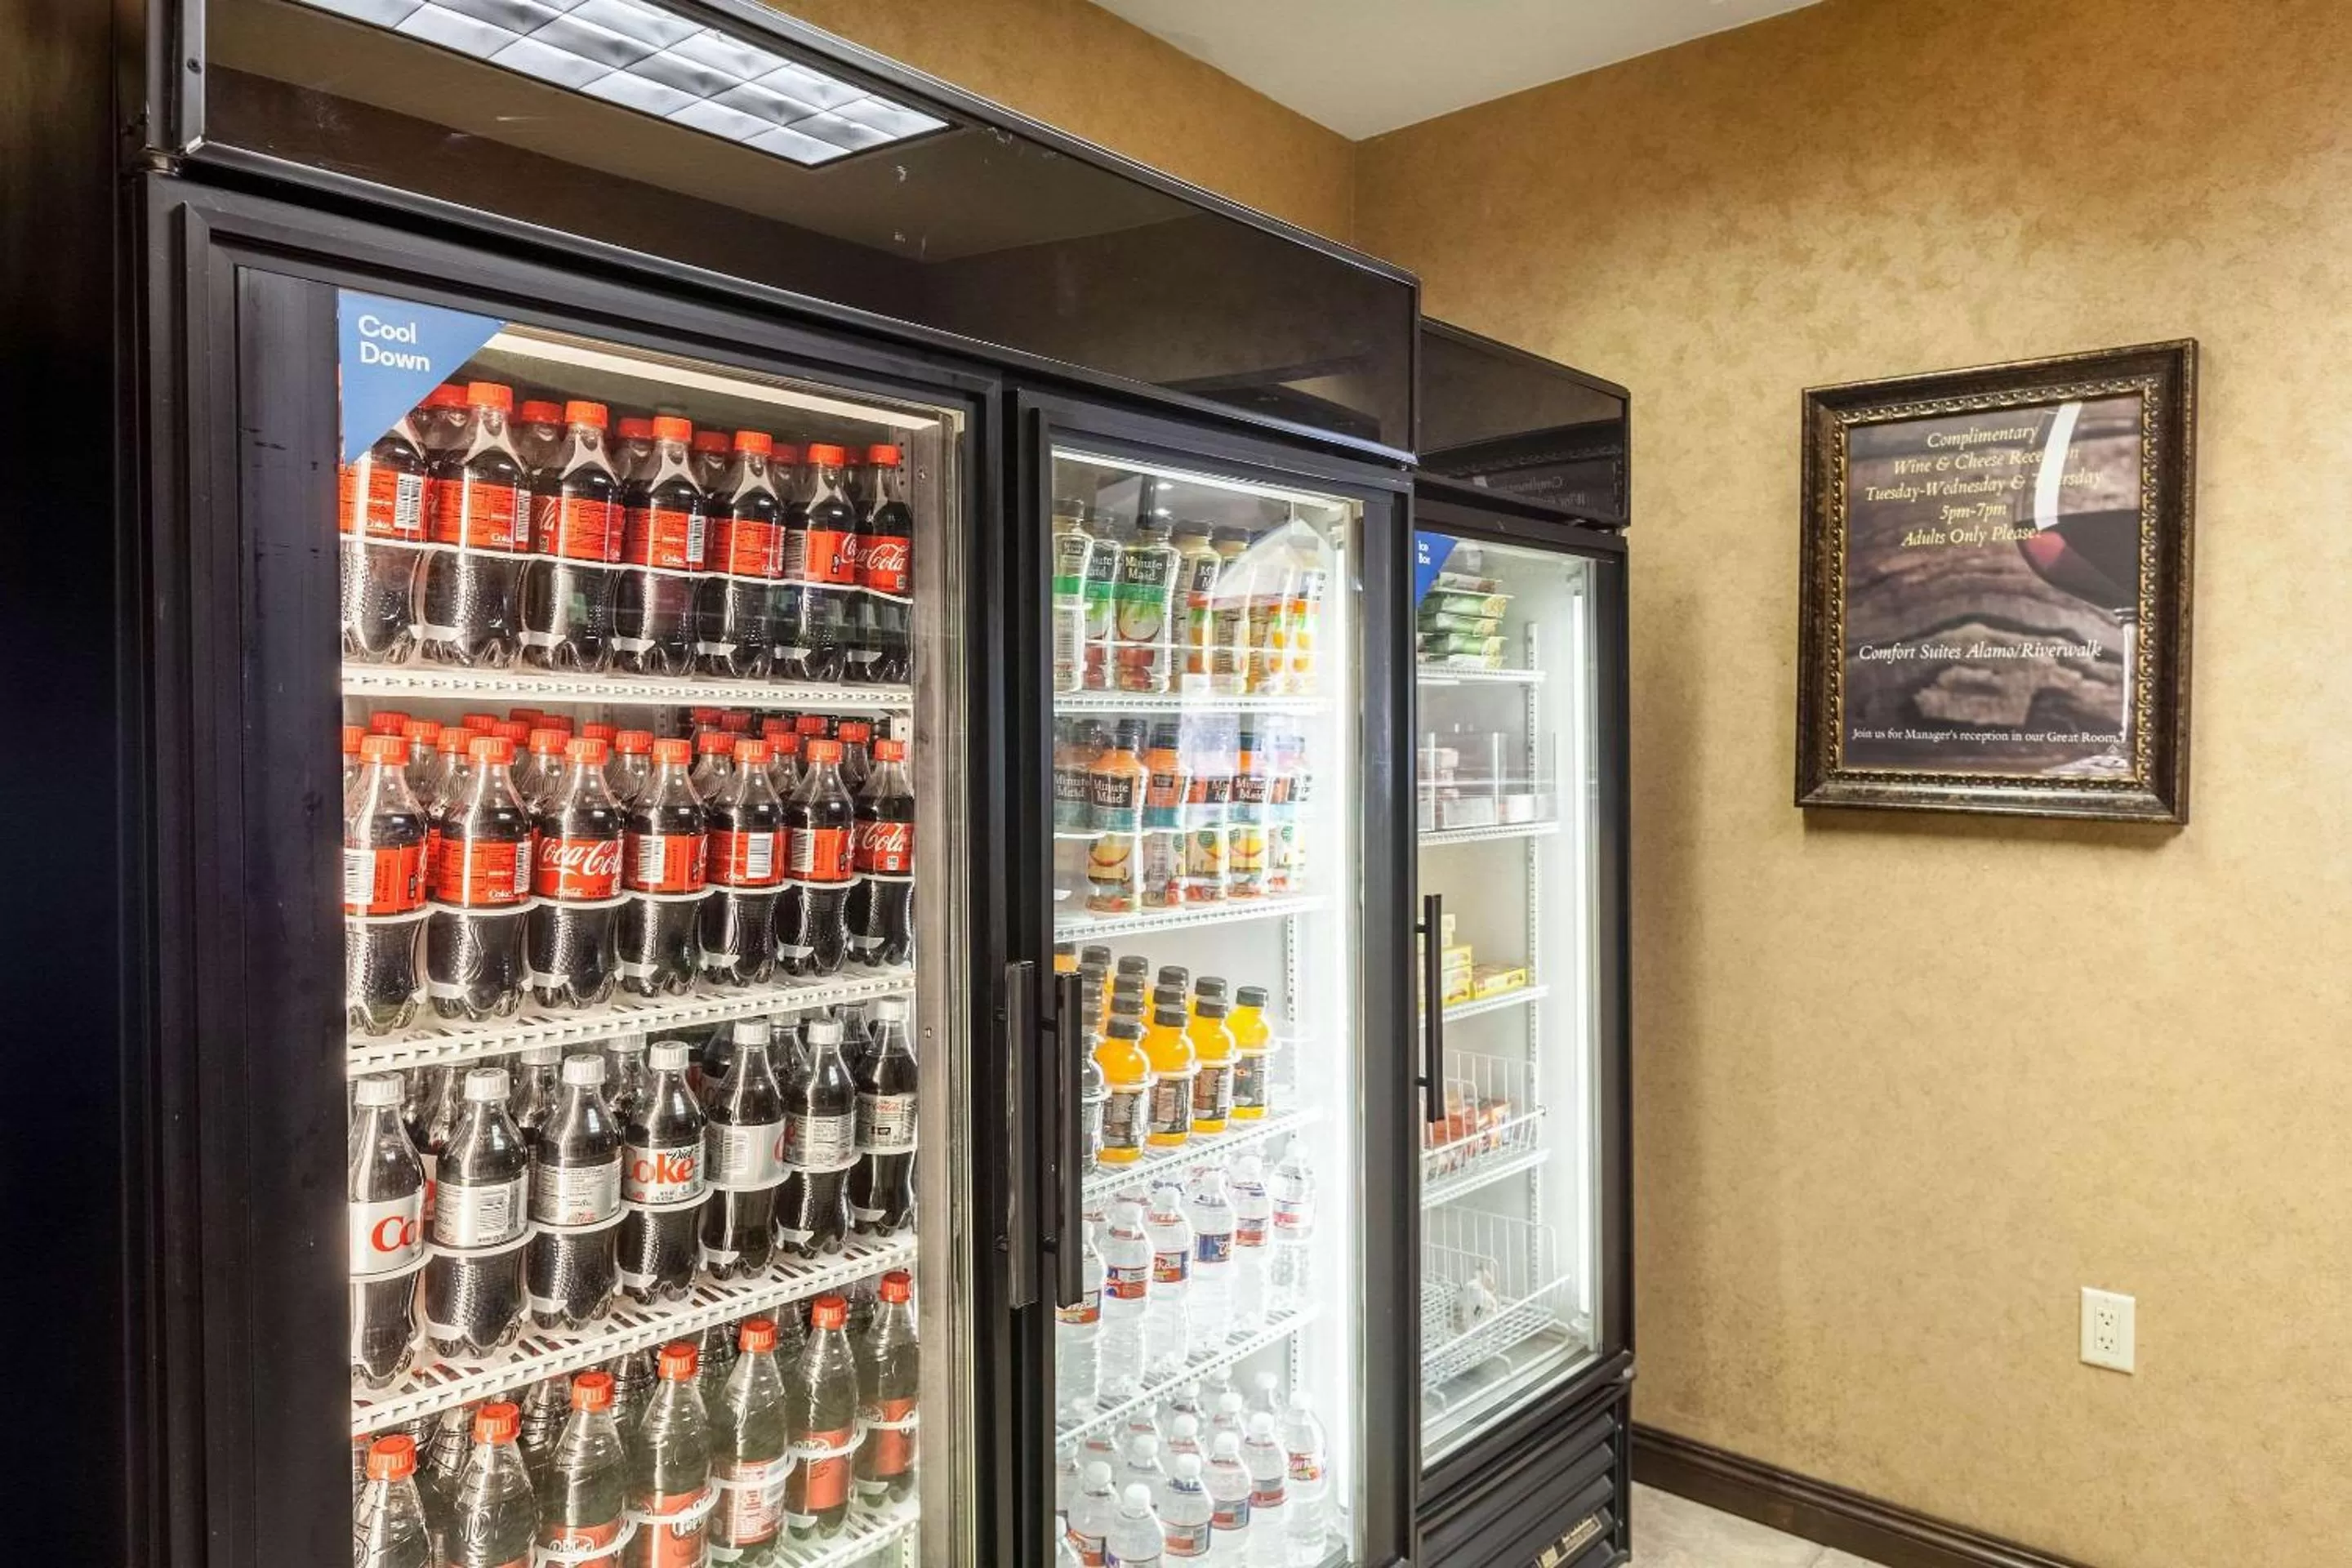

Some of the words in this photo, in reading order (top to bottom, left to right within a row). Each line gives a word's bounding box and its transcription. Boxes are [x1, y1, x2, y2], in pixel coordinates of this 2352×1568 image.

[358, 314, 417, 345] Cool
[359, 341, 431, 373] Down
[1927, 425, 2039, 450] Complimentary
[1894, 458, 1931, 475] Wine
[1936, 455, 1950, 471] &
[1954, 452, 2002, 471] Cheese
[2009, 447, 2079, 466] Recen
[1865, 474, 2005, 502] Tuesday-Wednesday
[2010, 474, 2025, 490] &
[2032, 467, 2103, 489] rsday
[1939, 501, 2007, 523] 5pm-7pm
[1901, 528, 1946, 548] Adults
[1949, 528, 1989, 547] Only
[1125, 555, 1164, 571] Minute
[1128, 567, 1158, 581] Maid
[1859, 642, 1916, 665] Comfort
[1919, 643, 1962, 660] Suites
[1964, 639, 2103, 660] Alamo/Riverwalk
[1851, 728, 1873, 742] Join
[1874, 729, 1886, 739] us
[1887, 727, 1904, 739] for
[1904, 728, 1958, 743] Manager's
[1959, 729, 2010, 745] reception
[2011, 728, 2023, 742] in
[2025, 732, 2045, 742] our
[2047, 731, 2080, 743] Great
[1094, 777, 1129, 793] Minute
[1097, 790, 1125, 804] Maid
[372, 1215, 419, 1252] Co
